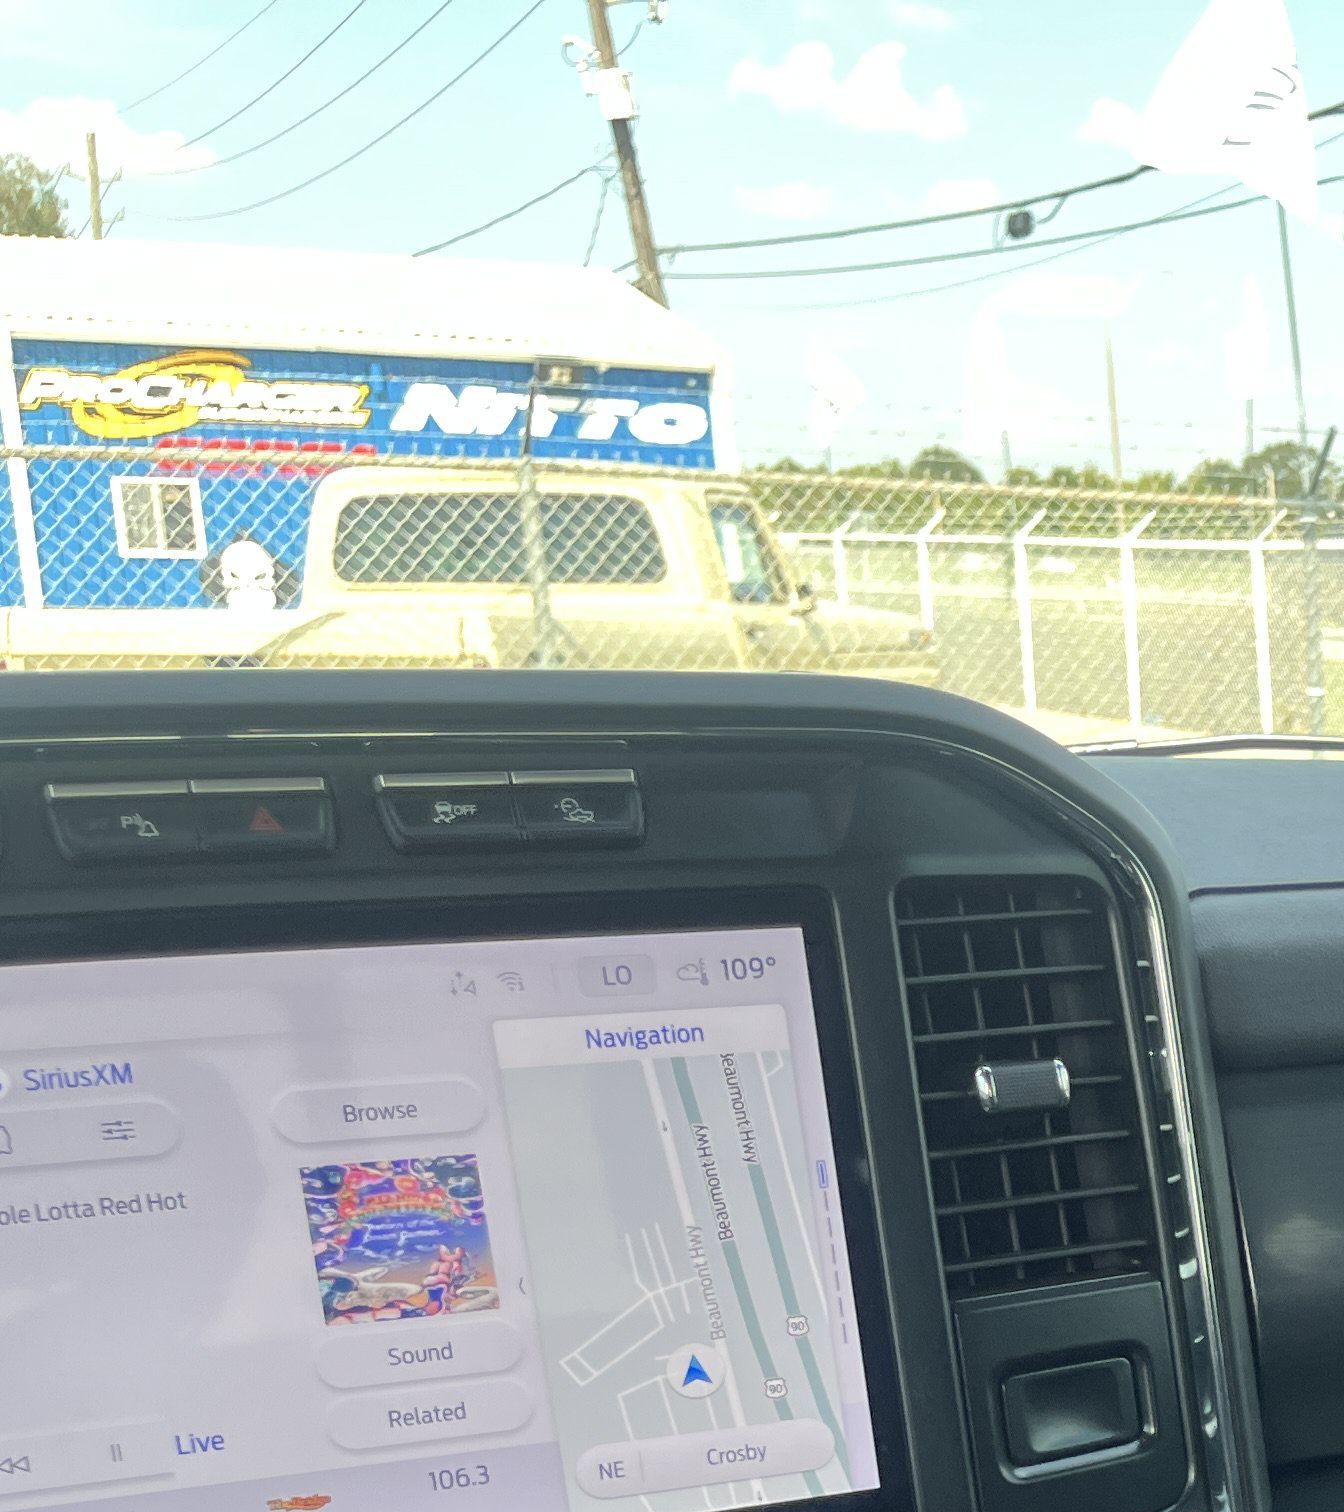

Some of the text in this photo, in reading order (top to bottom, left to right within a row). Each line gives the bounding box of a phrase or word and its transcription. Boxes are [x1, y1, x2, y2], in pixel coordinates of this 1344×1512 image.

[601, 964, 633, 987] LO
[585, 1023, 705, 1050] Navigation
[23, 1062, 134, 1092] SiriusXM
[342, 1101, 419, 1124] Browse
[741, 1128, 758, 1164] Hwy
[692, 1124, 735, 1241] Beaumont Hwy
[35, 1201, 96, 1222] Lotta
[100, 1194, 143, 1216] Red
[146, 1191, 188, 1213] Hot
[686, 1224, 727, 1341] Beaumont Hwy
[789, 1320, 805, 1333] 90
[387, 1341, 454, 1366] Sound
[768, 1382, 784, 1396] 90
[388, 1401, 467, 1428] Related
[175, 1432, 226, 1456] Live
[598, 1442, 767, 1481] NE Crosby
[428, 1464, 491, 1491] 106.3
